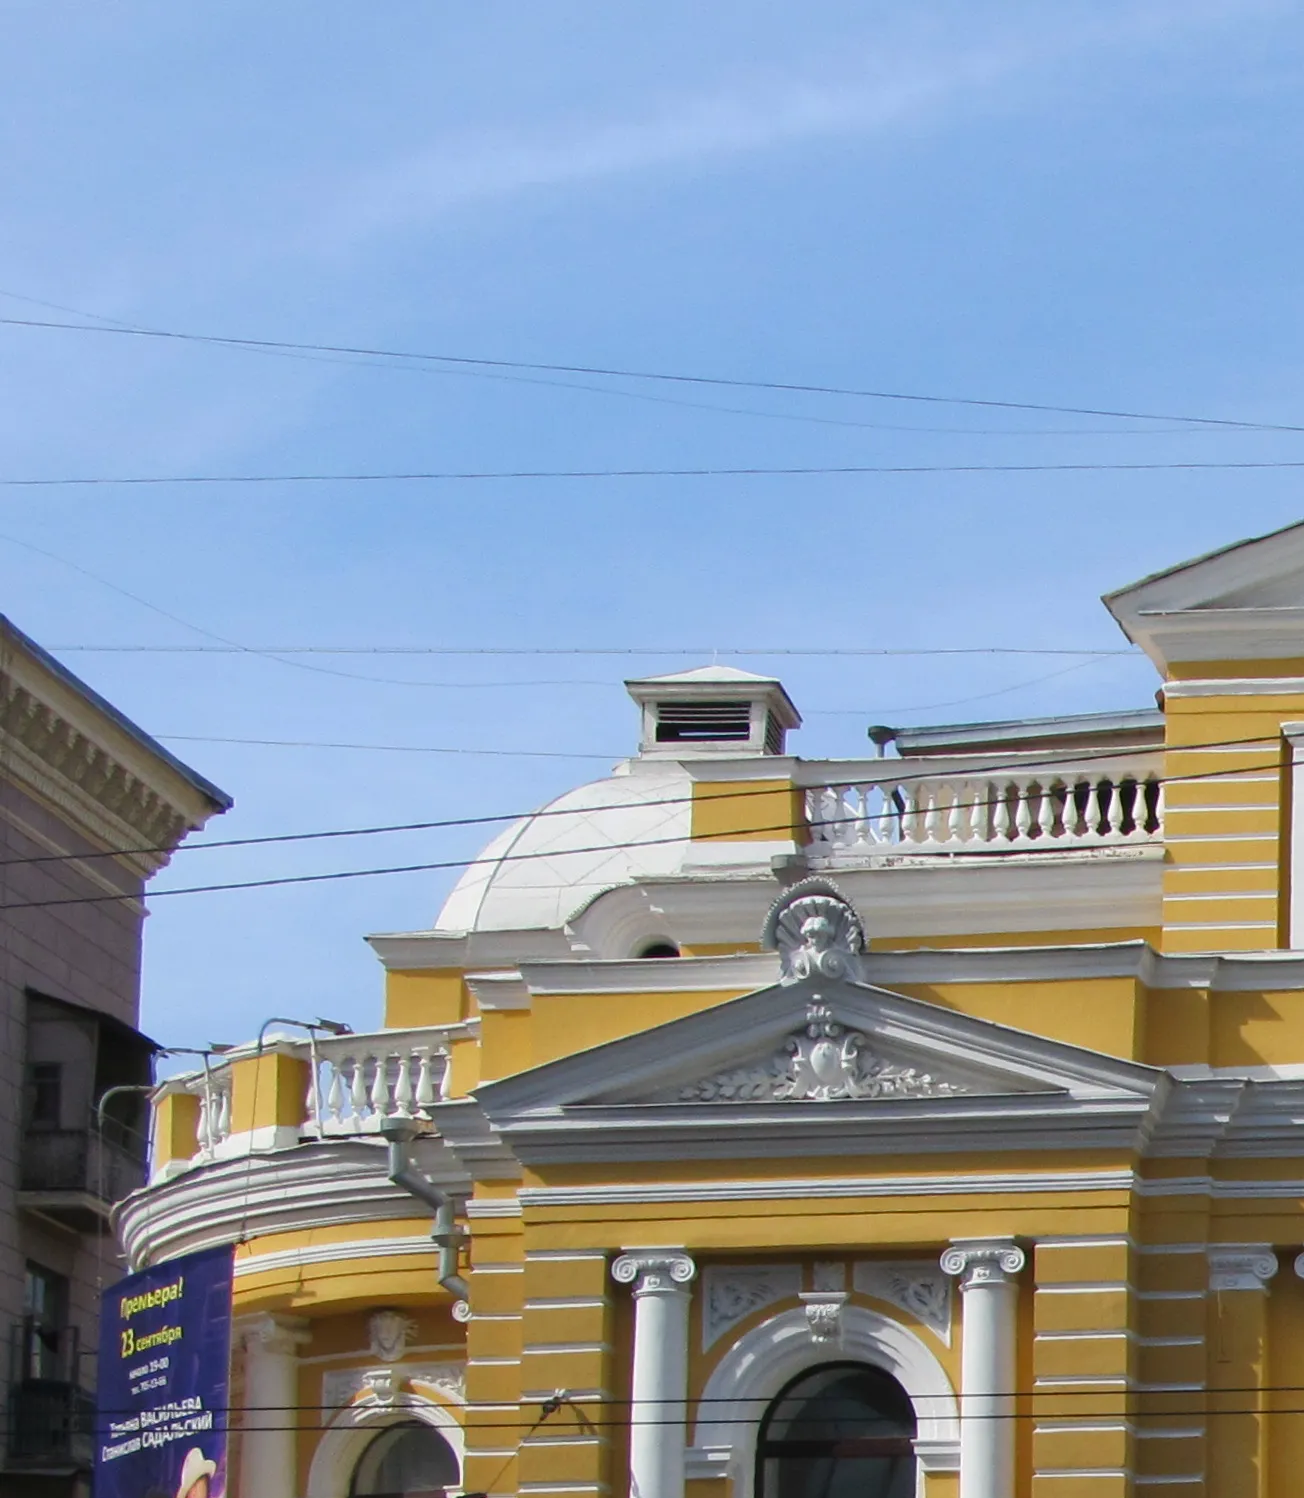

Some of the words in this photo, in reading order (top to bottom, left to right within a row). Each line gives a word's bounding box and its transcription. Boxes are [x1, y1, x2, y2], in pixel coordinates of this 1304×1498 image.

[121, 1276, 183, 1320] Премьера!
[121, 1328, 134, 1358] 23
[136, 1325, 182, 1351] сентября
[140, 1396, 202, 1428] ВАСИЛЬЕВА
[142, 1411, 213, 1448] САДАЛЬСКИЙ
